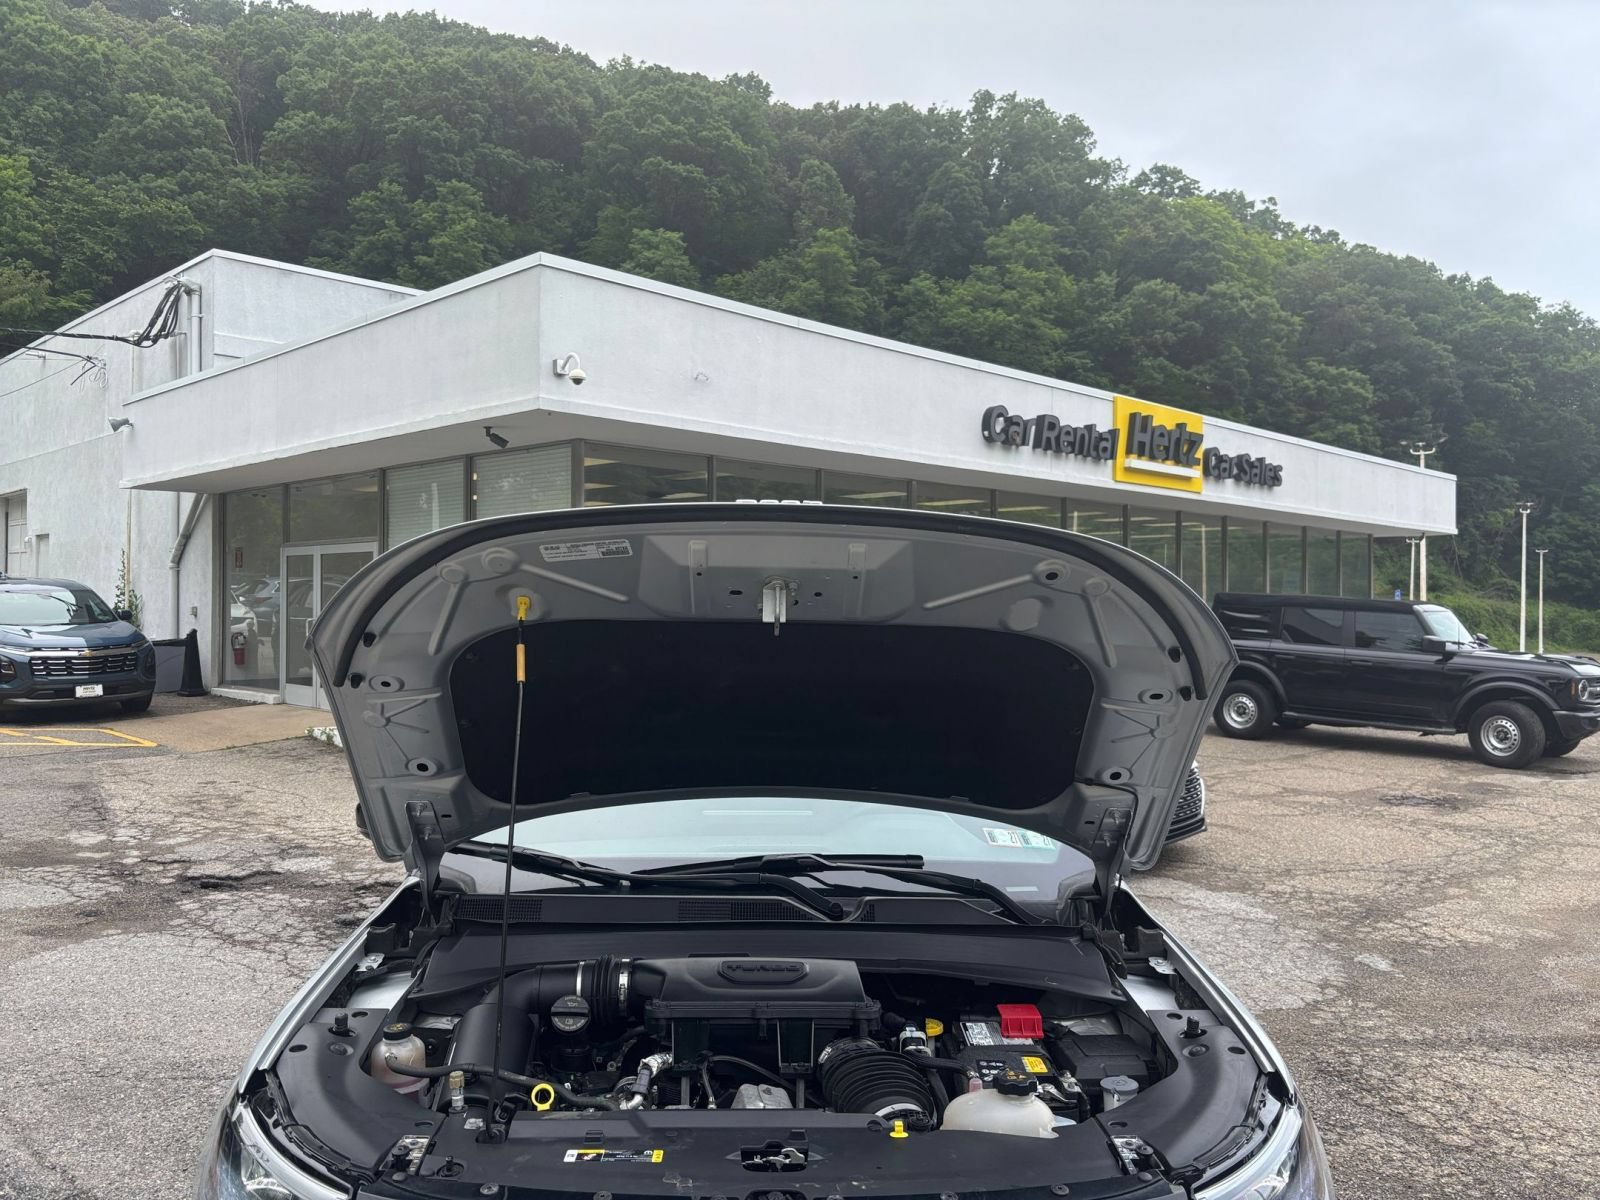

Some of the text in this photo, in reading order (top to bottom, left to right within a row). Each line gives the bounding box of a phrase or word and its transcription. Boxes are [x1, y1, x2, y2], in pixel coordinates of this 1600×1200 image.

[982, 405, 1120, 462] Car Rental
[1125, 412, 1204, 466] Hertz
[1203, 446, 1283, 487] Car Sales
